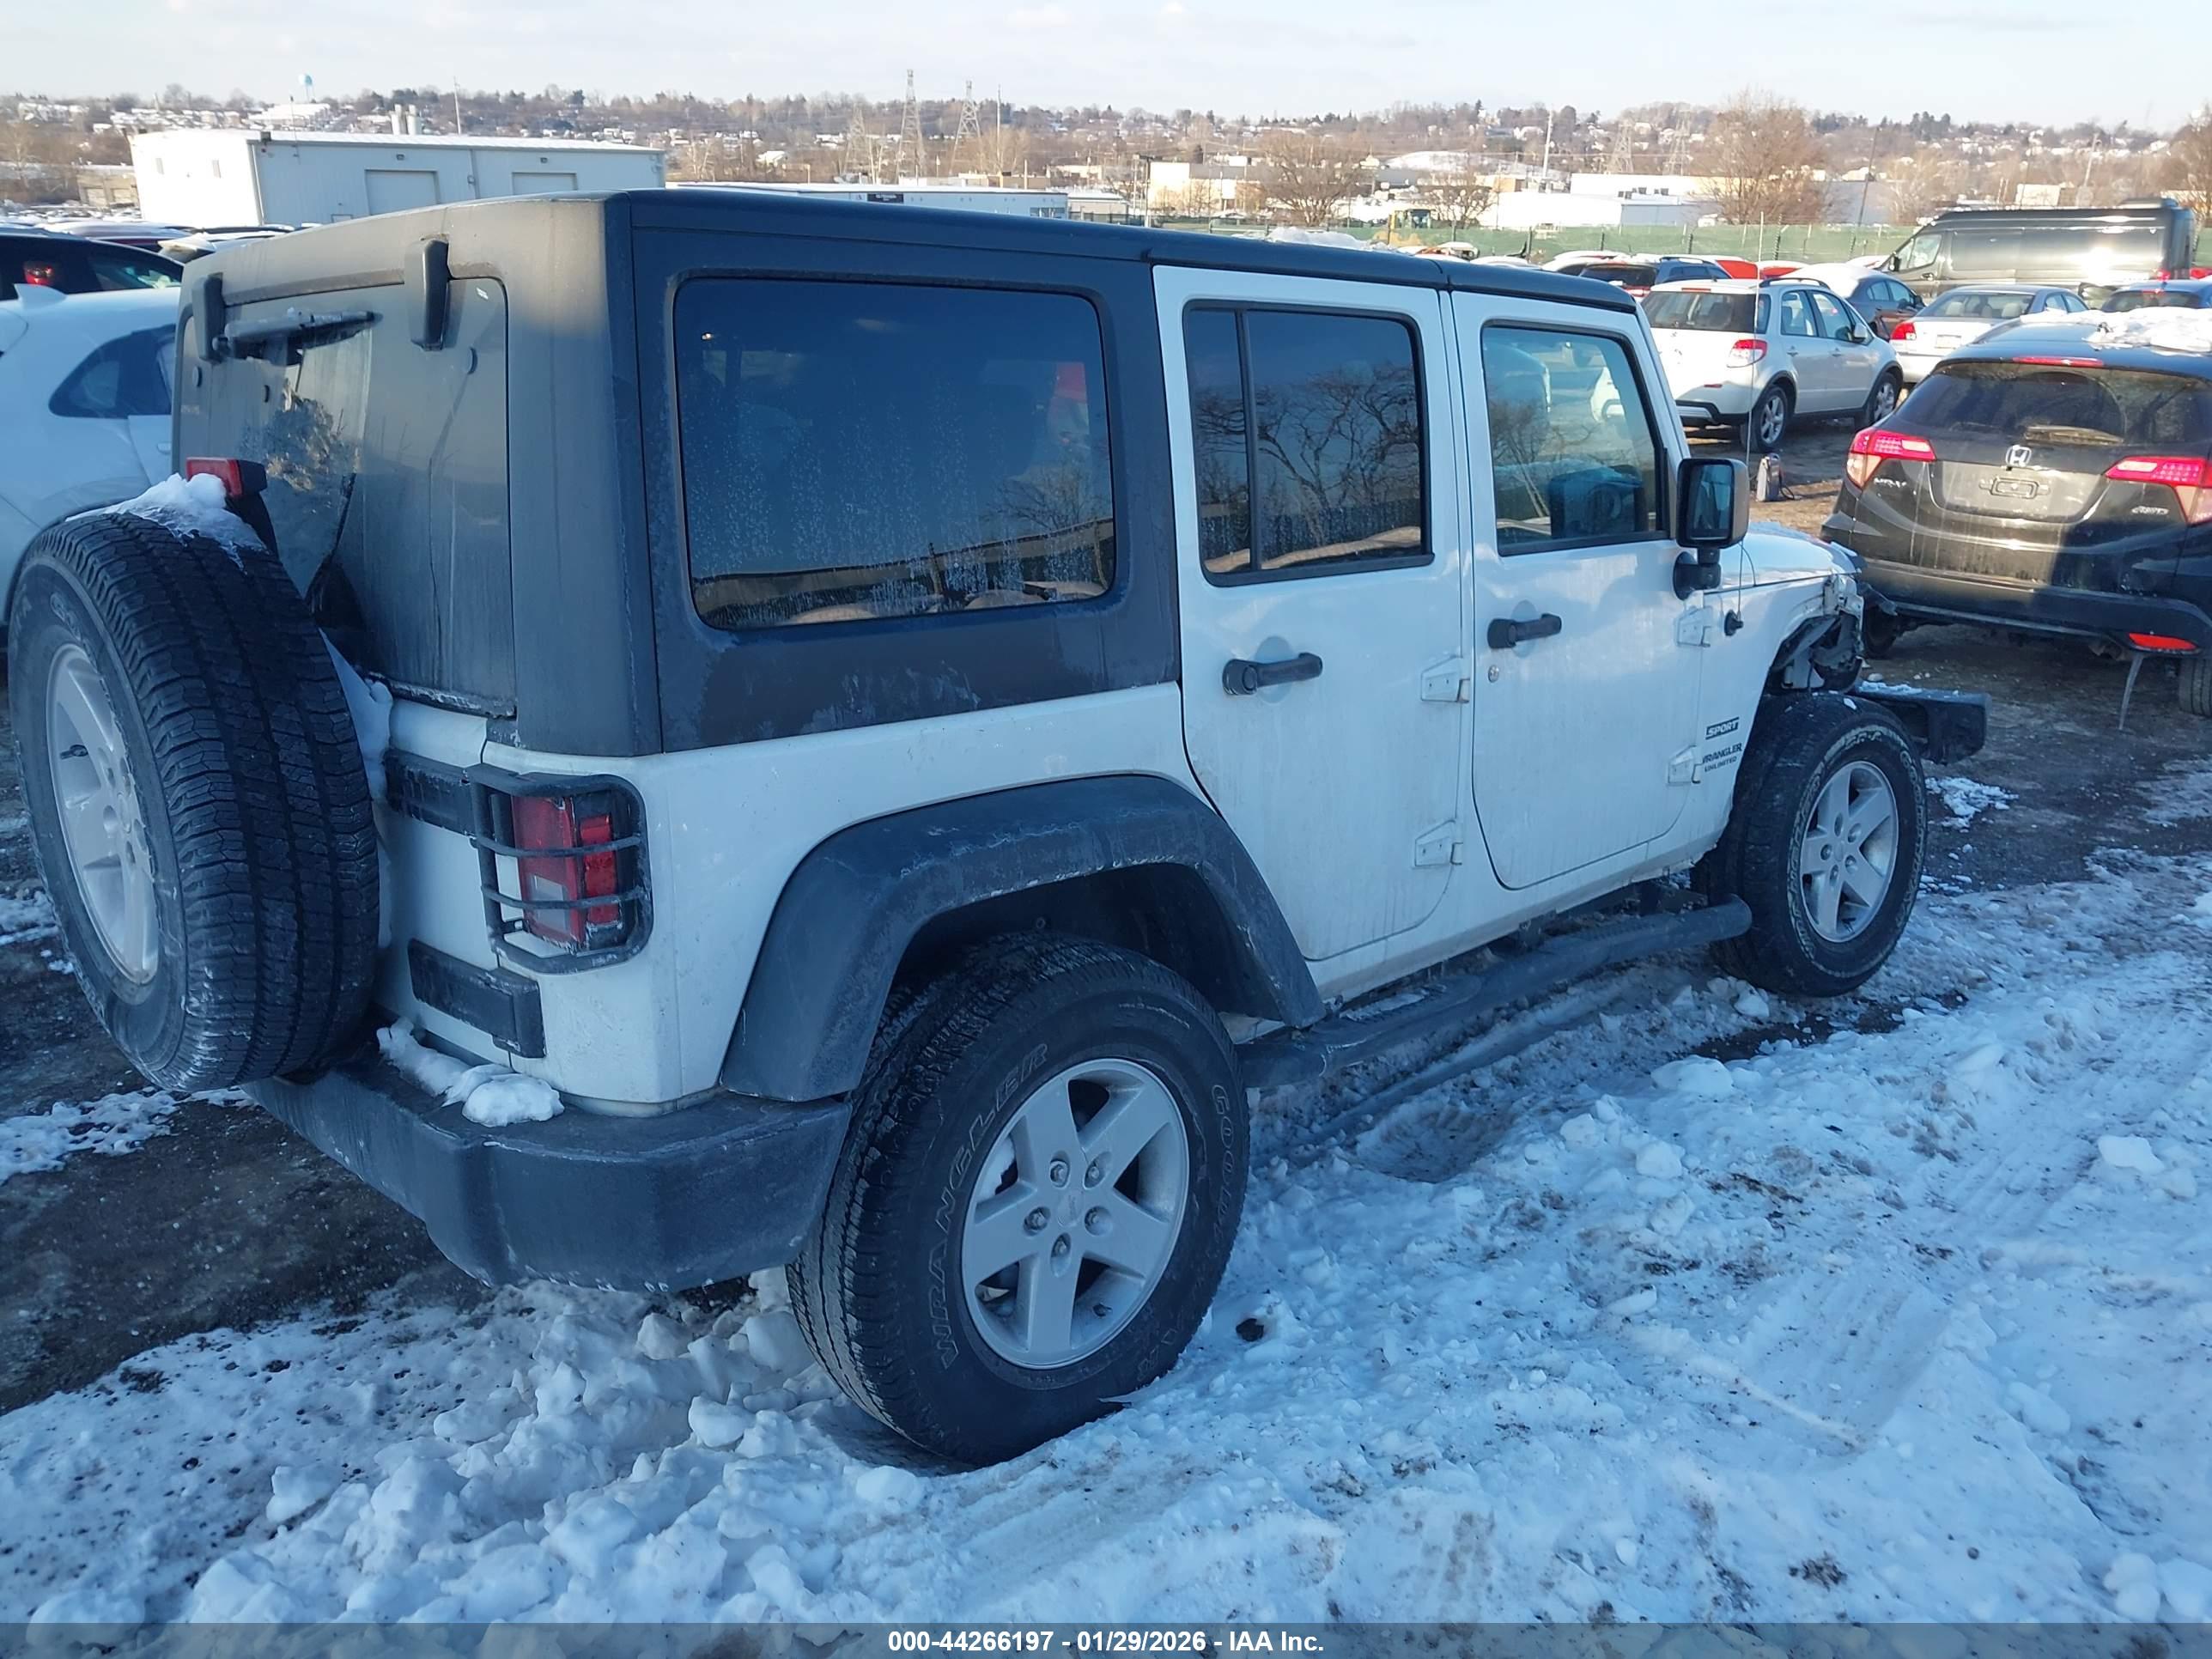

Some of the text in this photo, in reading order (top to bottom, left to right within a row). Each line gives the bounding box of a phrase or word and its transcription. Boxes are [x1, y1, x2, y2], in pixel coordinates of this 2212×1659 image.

[1705, 719, 1739, 738] SPORT
[1704, 756, 1739, 773] UNLIMITED
[927, 1042, 1049, 1370] WRANGLER
